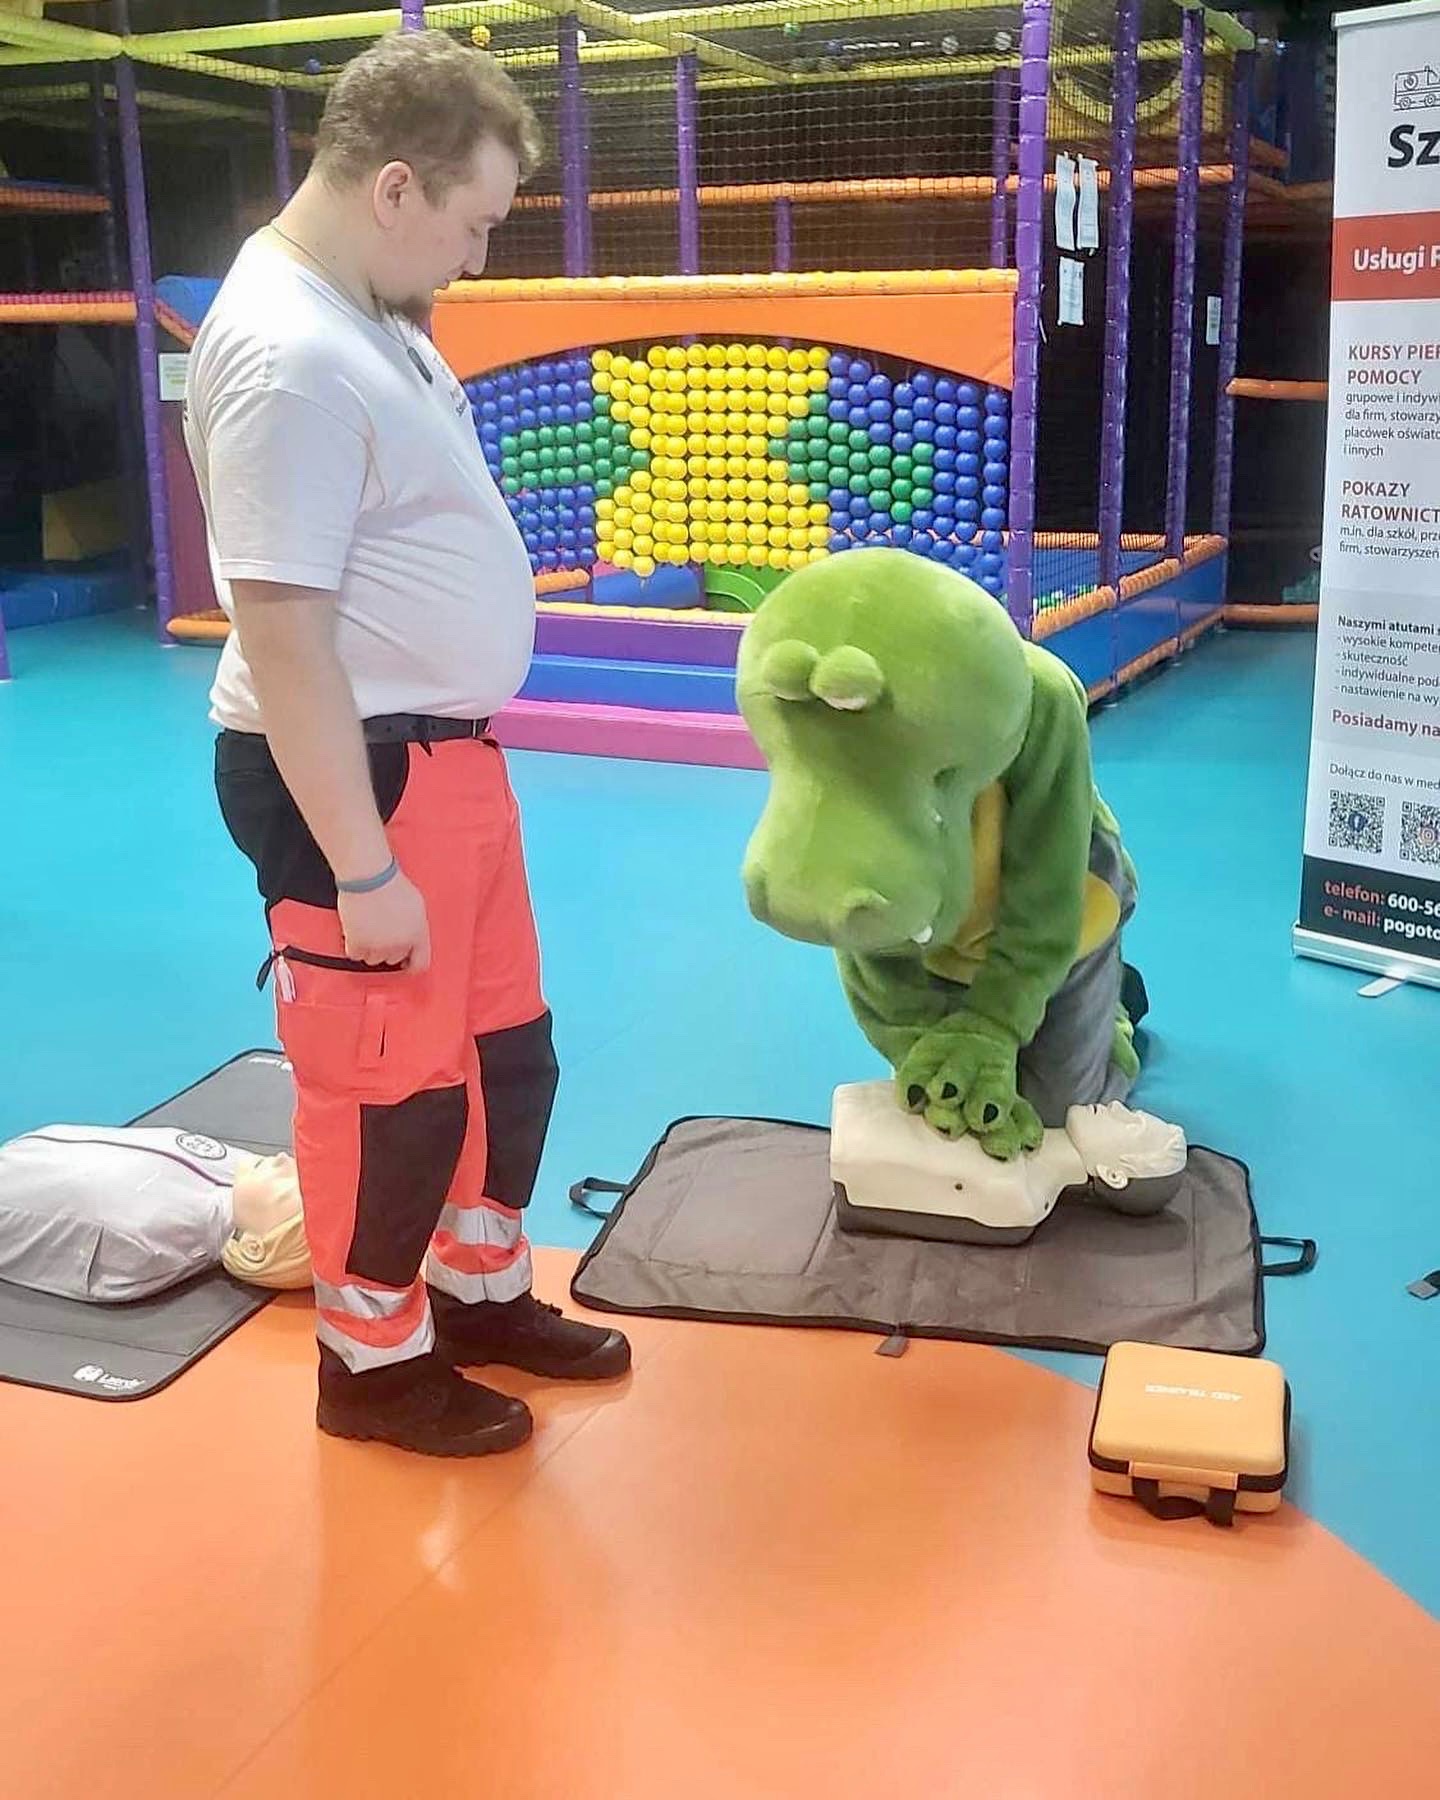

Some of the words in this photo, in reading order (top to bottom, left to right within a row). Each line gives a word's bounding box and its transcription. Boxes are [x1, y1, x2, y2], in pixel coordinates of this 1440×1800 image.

[1387, 124, 1440, 168] Sz
[1353, 245, 1426, 275] Usługi
[1348, 345, 1403, 360] KURSY
[1347, 369, 1422, 385] POMOCY
[1345, 392, 1394, 405] grupowe
[1345, 409, 1361, 420] dla
[1362, 408, 1387, 422] firm,
[1344, 426, 1394, 440] placówek
[1348, 444, 1384, 458] innych
[1342, 480, 1411, 497] POKAZY
[1366, 526, 1384, 538] dla
[1339, 540, 1362, 555] firm,
[1337, 615, 1386, 631] Naszymi
[1389, 621, 1435, 635] atutami
[1342, 635, 1387, 647] wysokie
[1341, 650, 1409, 667] skuteczność
[1341, 666, 1415, 684] indywidualne
[1341, 684, 1405, 700] nastawienie
[1407, 691, 1421, 702] na
[1332, 709, 1418, 737] Posiadamy
[1329, 762, 1366, 779] Dołącz
[1367, 769, 1382, 780] do
[1384, 773, 1403, 784] nas
[1404, 777, 1414, 786] w
[1324, 880, 1385, 906] telefon:
[1342, 909, 1381, 927] mail:
